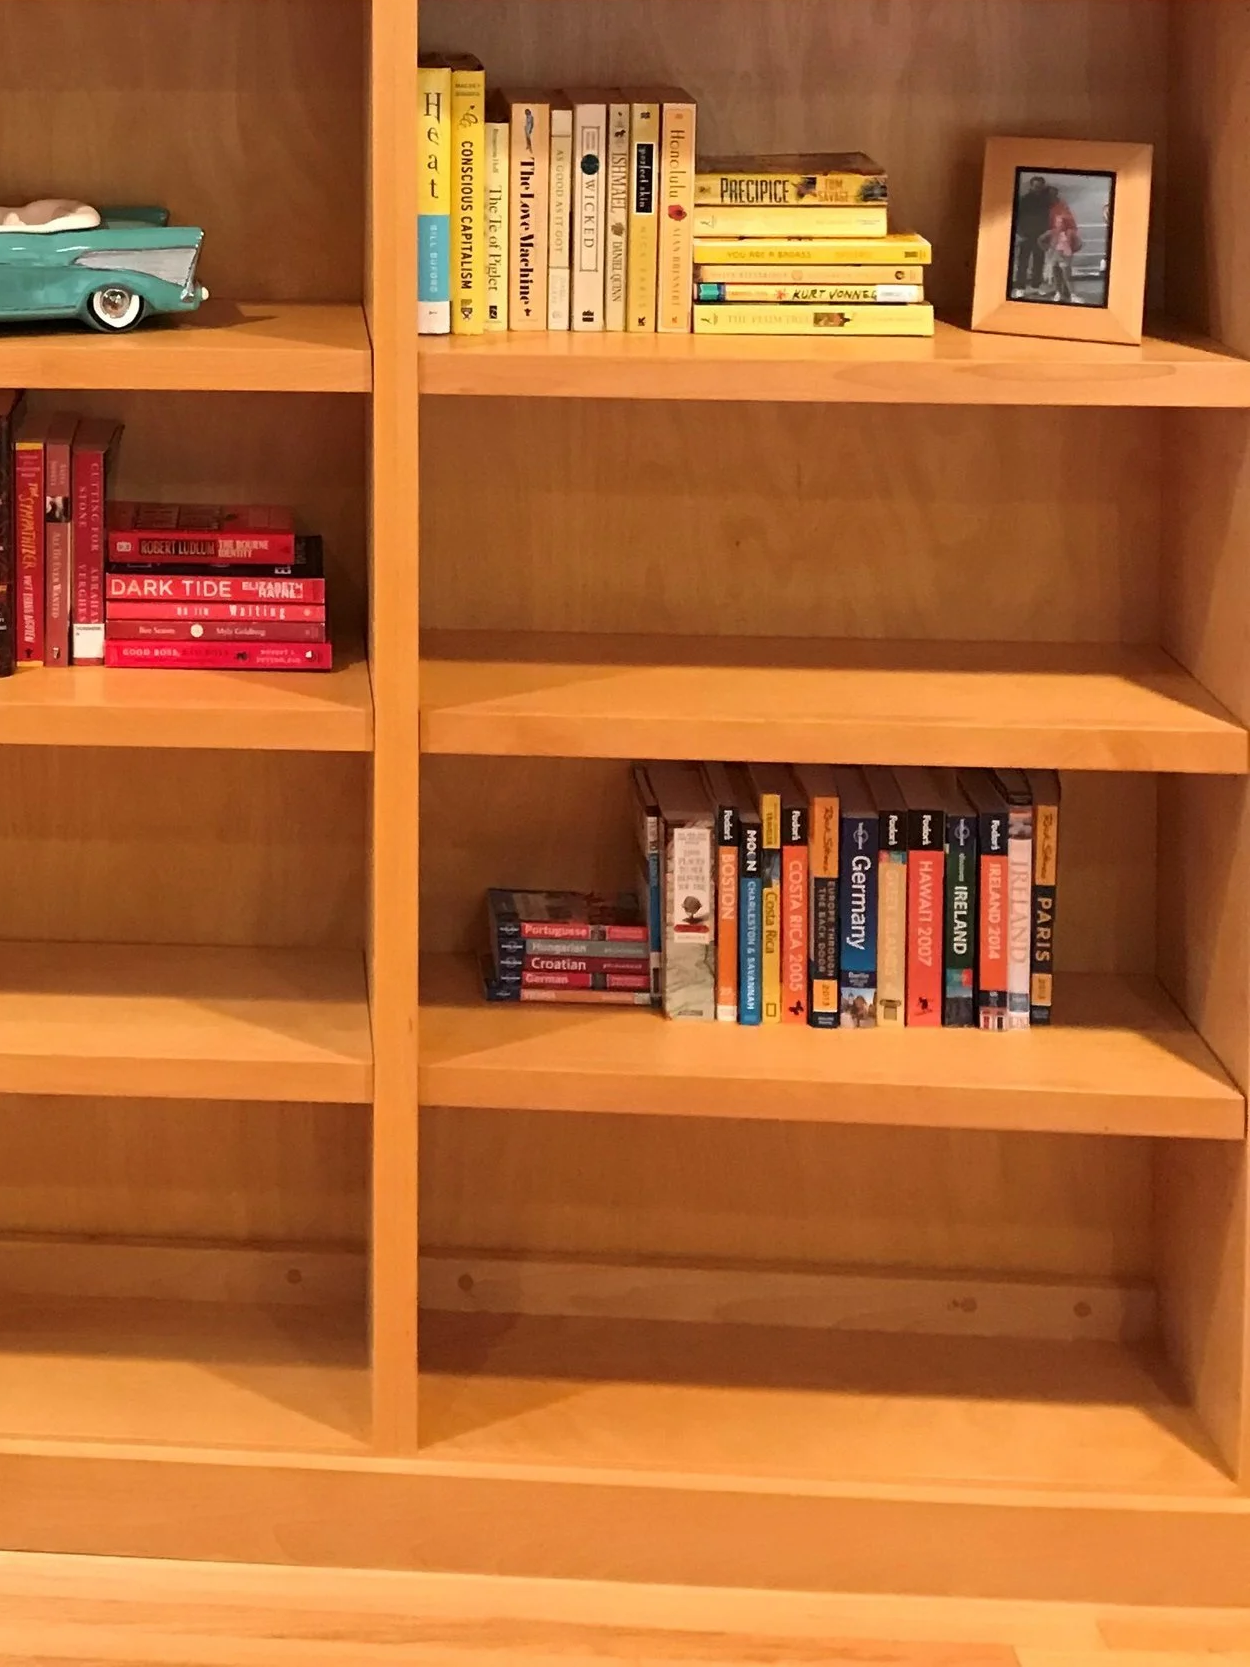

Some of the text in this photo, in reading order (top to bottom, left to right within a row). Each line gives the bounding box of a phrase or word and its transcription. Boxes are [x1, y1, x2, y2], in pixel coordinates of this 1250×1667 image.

[461, 140, 473, 289] CONSCIOUS CAPITALISM
[584, 179, 596, 248] WICKED
[720, 177, 790, 204] PRECIPICE
[485, 186, 502, 291] The Te of Piglet
[519, 157, 535, 305] The Love Machine
[610, 152, 626, 302] ISHMAEL DANIEL QUINN
[792, 290, 878, 300] KURT VONNEG
[78, 486, 87, 528] STONE
[90, 462, 100, 552] CUTTING FOR
[77, 563, 87, 623] VERGHES
[111, 579, 232, 597] DARK TIDE
[721, 809, 734, 919] Fodor's BOSTON
[746, 829, 757, 871] MOON
[747, 881, 756, 945] CHARLESTON
[765, 891, 777, 954] Costa Rica
[789, 810, 803, 992] Fodor's COSTA RICA 2005
[846, 855, 872, 950] Germany
[953, 885, 968, 955] IRELAND
[989, 820, 1001, 960] Fodor's IRELAND 2014
[1009, 861, 1028, 965] IRELAND
[524, 924, 587, 937] Portuguese
[532, 942, 586, 954] Hungarian
[818, 887, 826, 972] THE BACK DOOR
[827, 881, 835, 976] EUROPE THROUGH
[1035, 896, 1052, 961] PARIS
[525, 974, 569, 984] German
[531, 957, 586, 971] Croatian
[747, 957, 756, 1010] SAVANNAH
